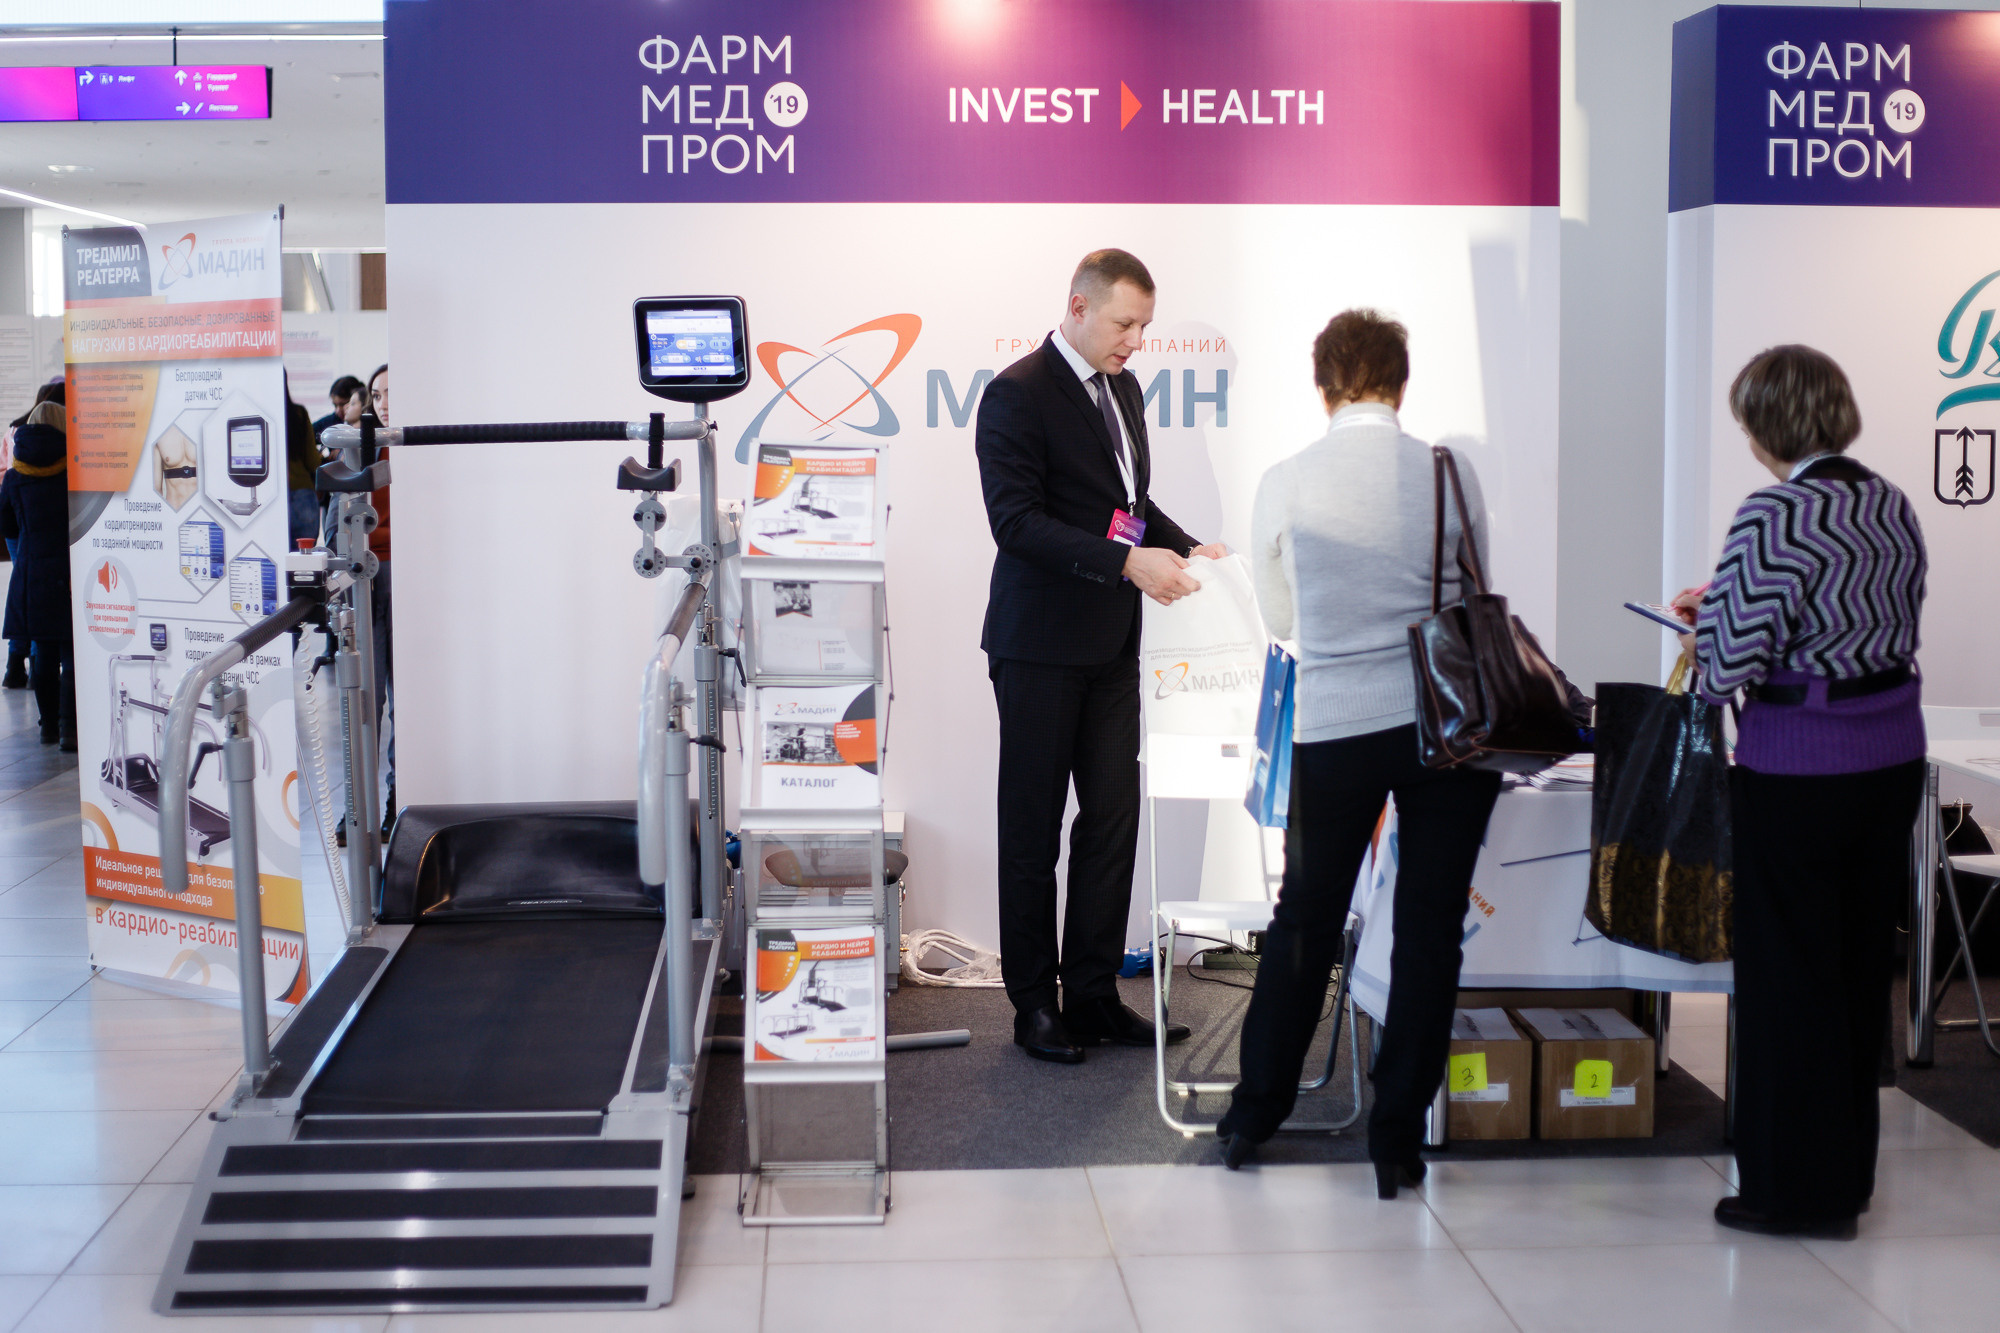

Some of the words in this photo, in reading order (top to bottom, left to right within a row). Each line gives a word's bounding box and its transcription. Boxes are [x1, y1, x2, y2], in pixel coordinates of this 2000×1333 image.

[638, 34, 792, 74] ФАРМ
[1767, 41, 1911, 82] ФАРМ
[642, 84, 754, 131] МЕД
[949, 87, 1100, 123] INVEST
[1163, 88, 1324, 125] HEALTH
[1769, 89, 1874, 136] МЕД
[642, 134, 795, 174] ПРОМ
[1769, 139, 1912, 178] ПРОМ
[77, 245, 140, 266] ТРЕДМИЛ
[198, 247, 264, 278] МАДИН
[77, 266, 140, 286] РЕАТЕРРА
[70, 318, 146, 333] ИНДИВИДУАЛЬНЫЕ,
[206, 311, 276, 327] ДОЗИРОВАННЫЕ
[72, 336, 126, 354] НАГРУЗКИ
[128, 336, 136, 351] В
[138, 330, 277, 353] КАРДИОРЕАБИЛИТАЦИИ
[175, 368, 223, 384] Беспроводной
[185, 390, 208, 403] датчик
[209, 387, 223, 401] ЧСС
[926, 369, 1228, 428] МИН
[806, 466, 866, 474] РЕАБИЛИТАЦИЯ
[124, 498, 162, 514] Проведение
[104, 520, 163, 533] кардиотренировки
[93, 538, 100, 548] по
[101, 536, 131, 550] заданной
[132, 539, 163, 552] мощности
[184, 627, 225, 643] Проведение
[256, 655, 281, 668] рамках
[222, 671, 244, 685] раниц
[245, 670, 260, 684] ЧСС
[1192, 669, 1261, 692] МАДИН
[798, 707, 837, 715] МАДИН
[781, 777, 838, 788] КАТАЛОГ
[95, 856, 143, 875] Идеальное
[108, 909, 299, 960] кардио-реабилации
[847, 940, 870, 949] НЕЙРО
[811, 947, 870, 957] РЕАБИЛИТАЦИЯ
[1461, 1067, 1475, 1087] 3
[1591, 1073, 1599, 1089] 2
